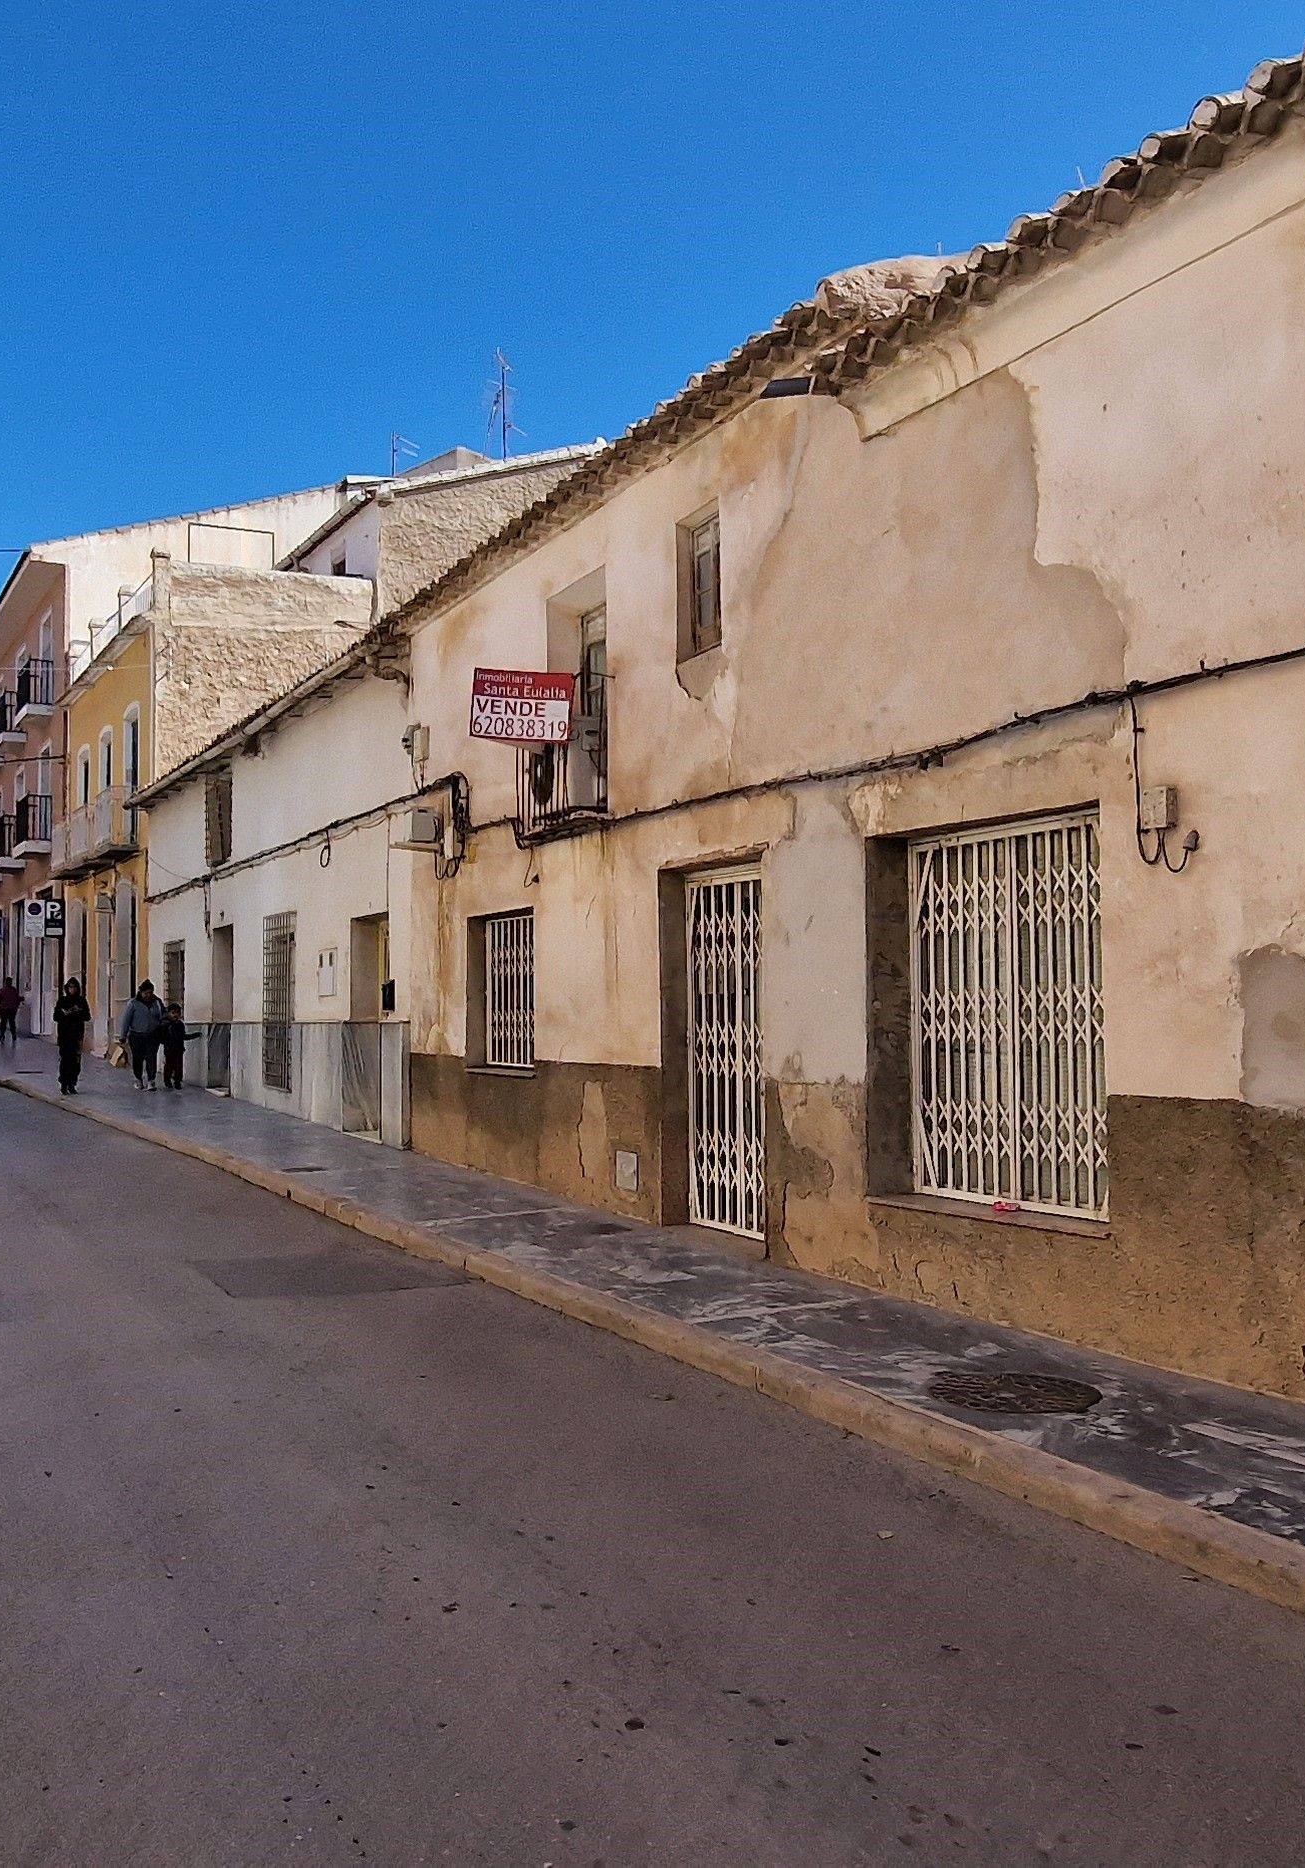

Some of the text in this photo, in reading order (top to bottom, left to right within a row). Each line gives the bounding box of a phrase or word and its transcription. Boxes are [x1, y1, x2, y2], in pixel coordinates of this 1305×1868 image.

[476, 671, 533, 684] Inmobiliaria
[484, 683, 566, 699] Santa Eulalia
[476, 698, 546, 717] VENDE
[473, 716, 567, 739] 620838319
[46, 901, 61, 919] P
